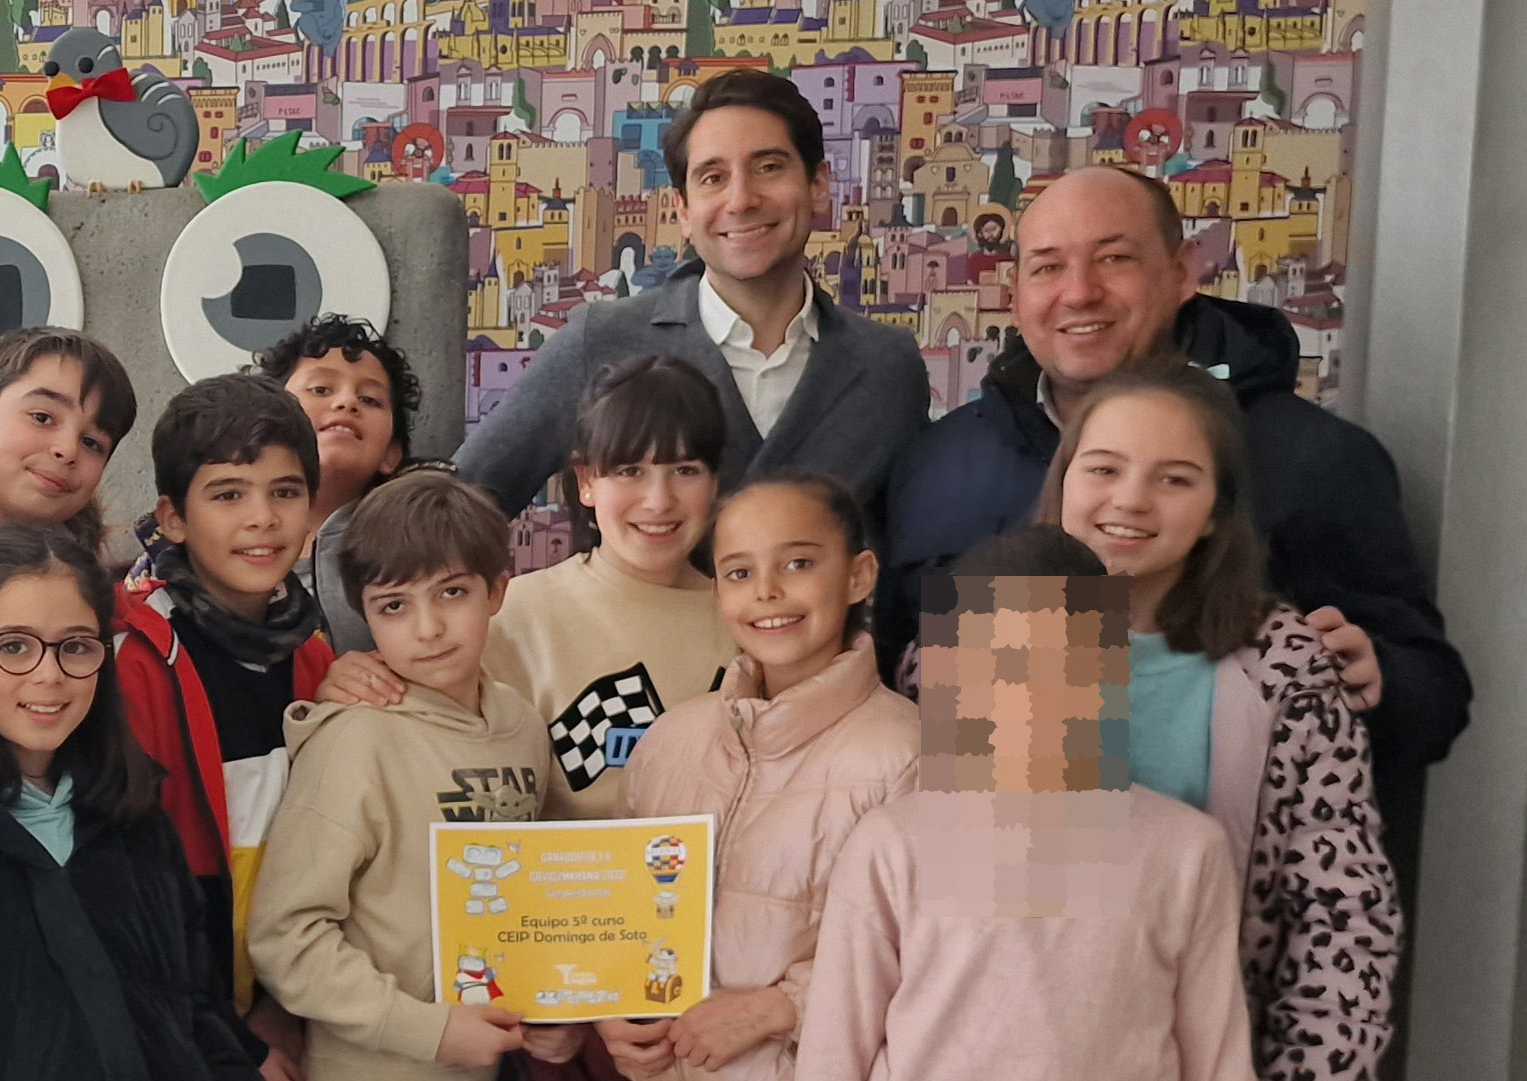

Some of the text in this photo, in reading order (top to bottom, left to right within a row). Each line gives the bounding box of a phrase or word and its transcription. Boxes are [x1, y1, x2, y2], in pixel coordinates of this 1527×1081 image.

[521, 916, 568, 929] Equipo
[591, 916, 624, 926] curso
[497, 929, 647, 944] CEIP Domingo de Soto
